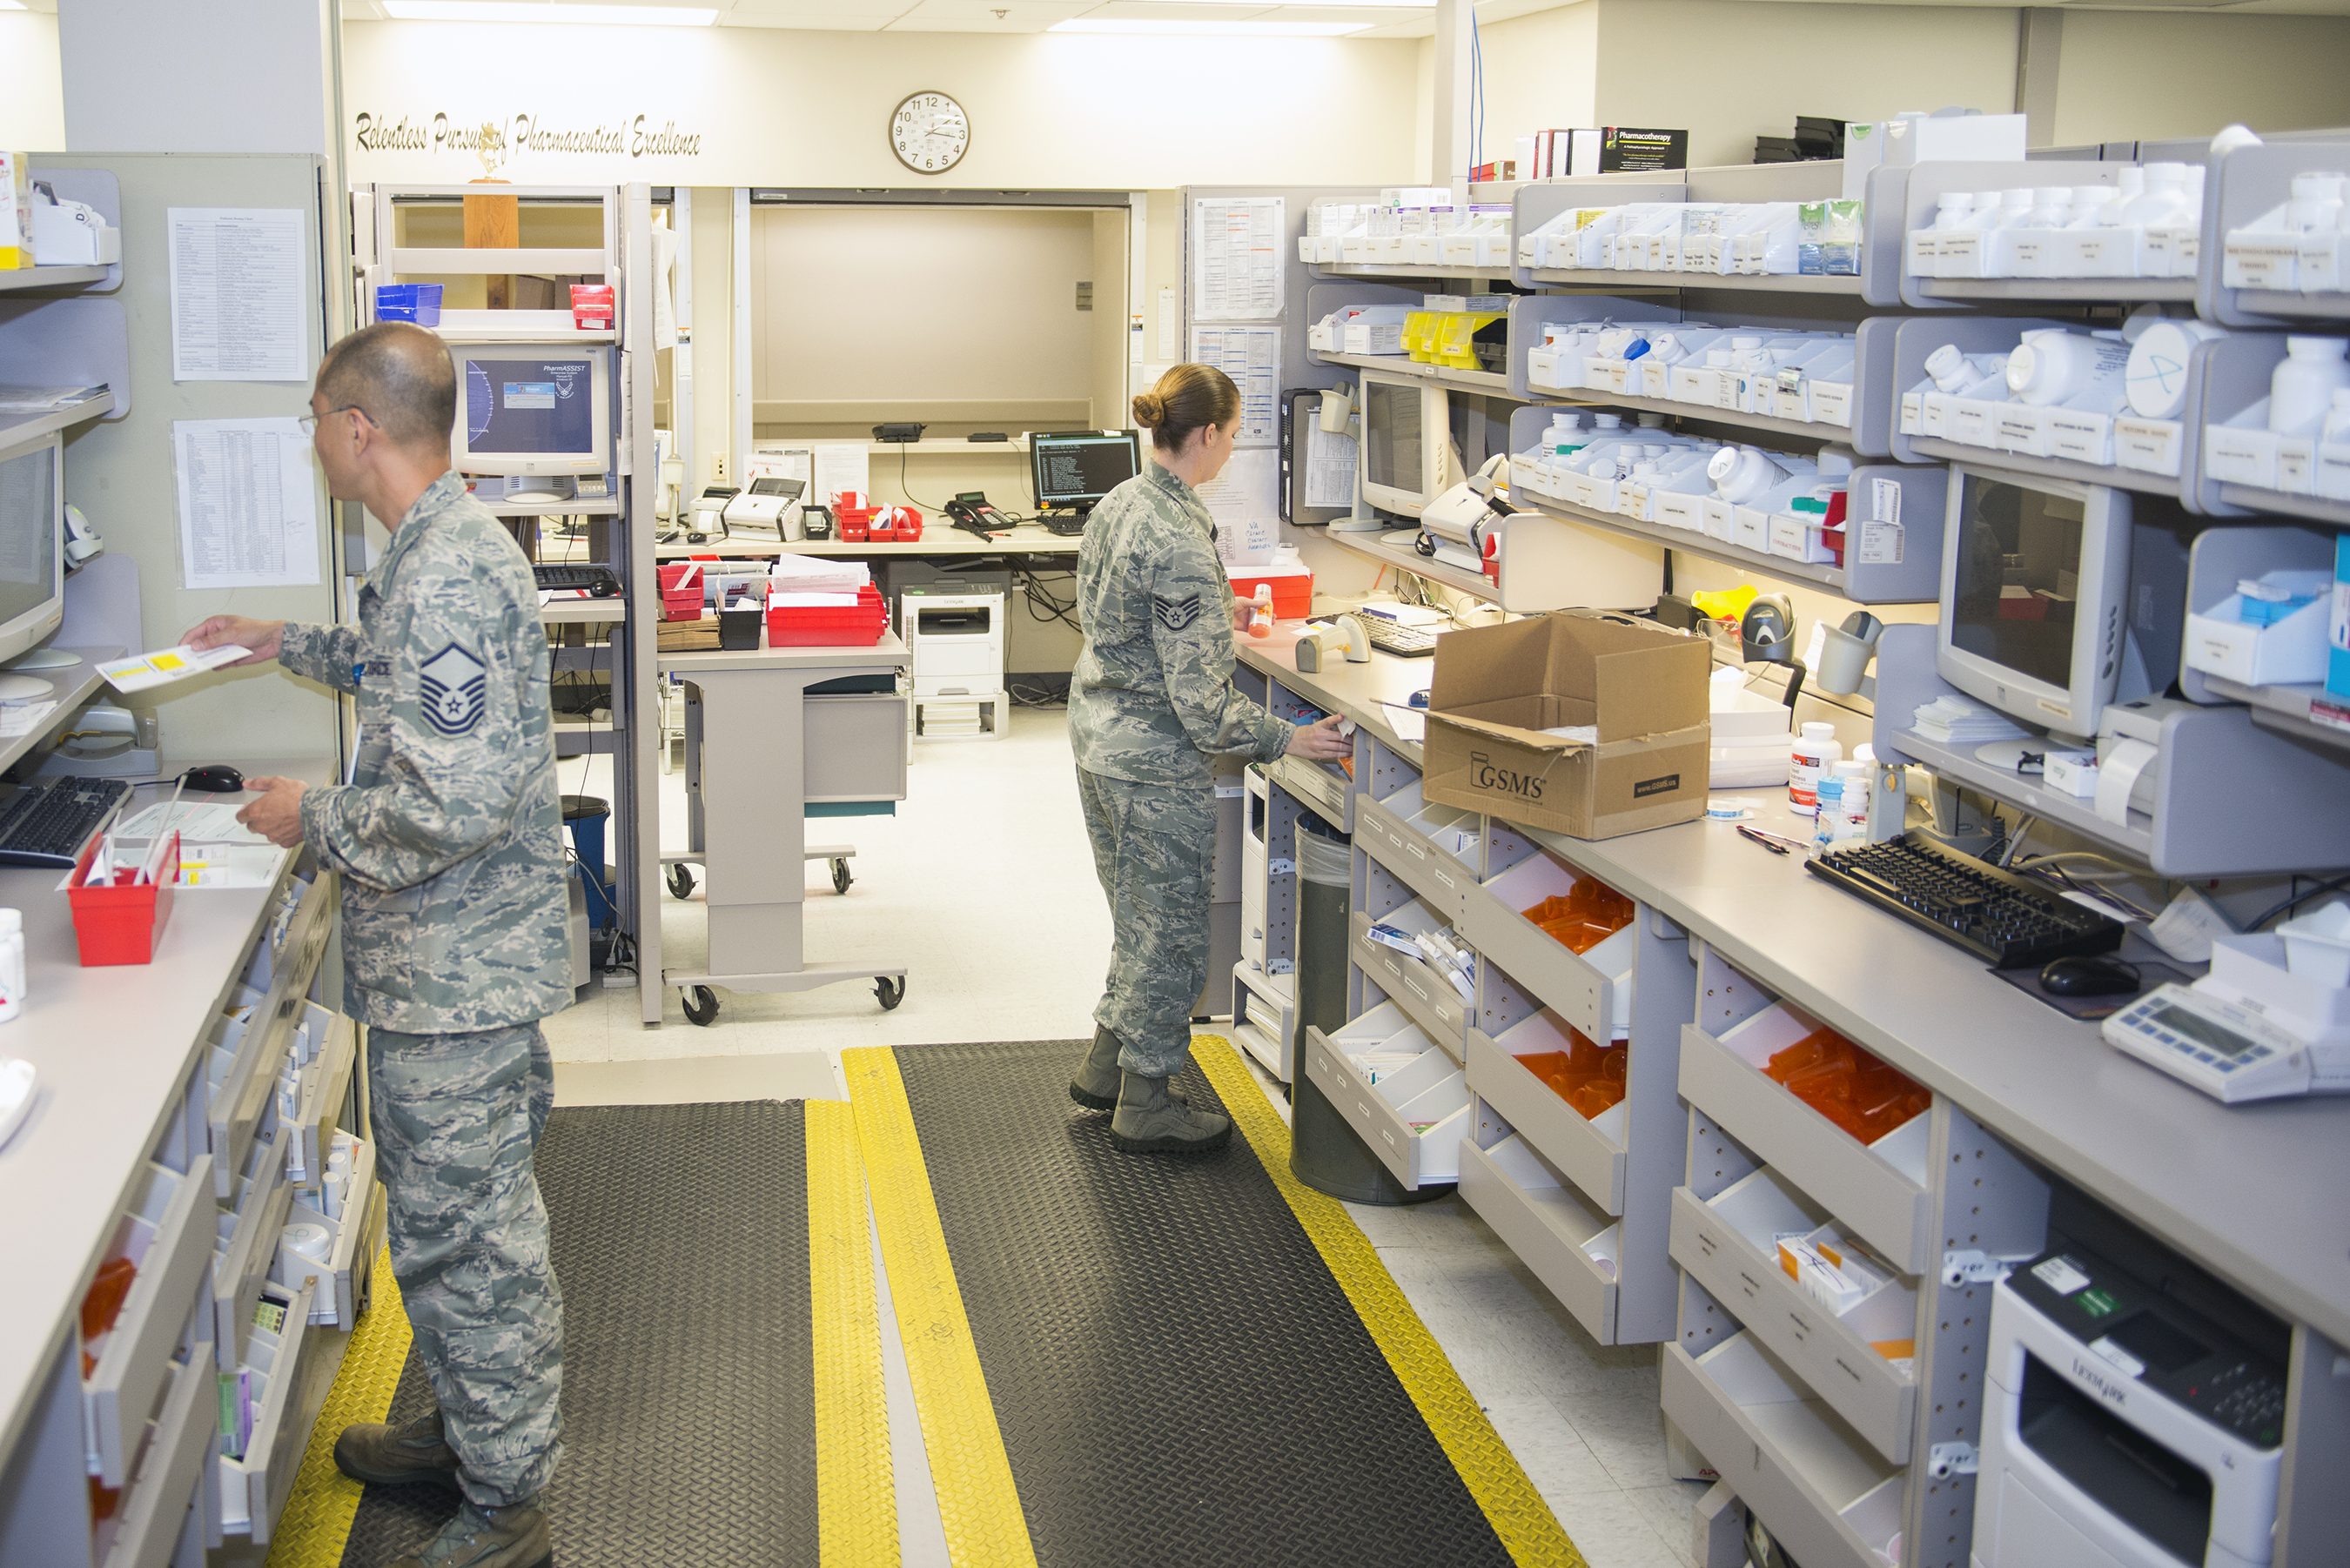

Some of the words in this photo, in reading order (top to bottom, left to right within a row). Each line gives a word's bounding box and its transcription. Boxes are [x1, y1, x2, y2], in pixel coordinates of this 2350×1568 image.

[911, 99, 921, 111] 11
[924, 97, 938, 107] 12
[945, 102, 950, 112] 1
[898, 111, 911, 122] 10
[896, 125, 903, 137] 9
[958, 130, 966, 140] 3
[356, 111, 428, 153] Relentless
[495, 115, 510, 166] of
[515, 113, 627, 157] Pharmaceutical
[632, 114, 702, 158] Excellence
[1619, 131, 1671, 143] Pharmacotherapy
[899, 141, 906, 152] 8
[953, 144, 960, 155] 4
[911, 153, 919, 164] 7
[926, 158, 933, 169] 6
[941, 155, 949, 165] 5
[1249, 521, 1259, 530] VA
[1773, 539, 1792, 550] CONTRACT
[1791, 544, 1802, 553] ITEM
[1480, 766, 1542, 799] GSMS
[1636, 779, 1677, 794] www.GSMS.us
